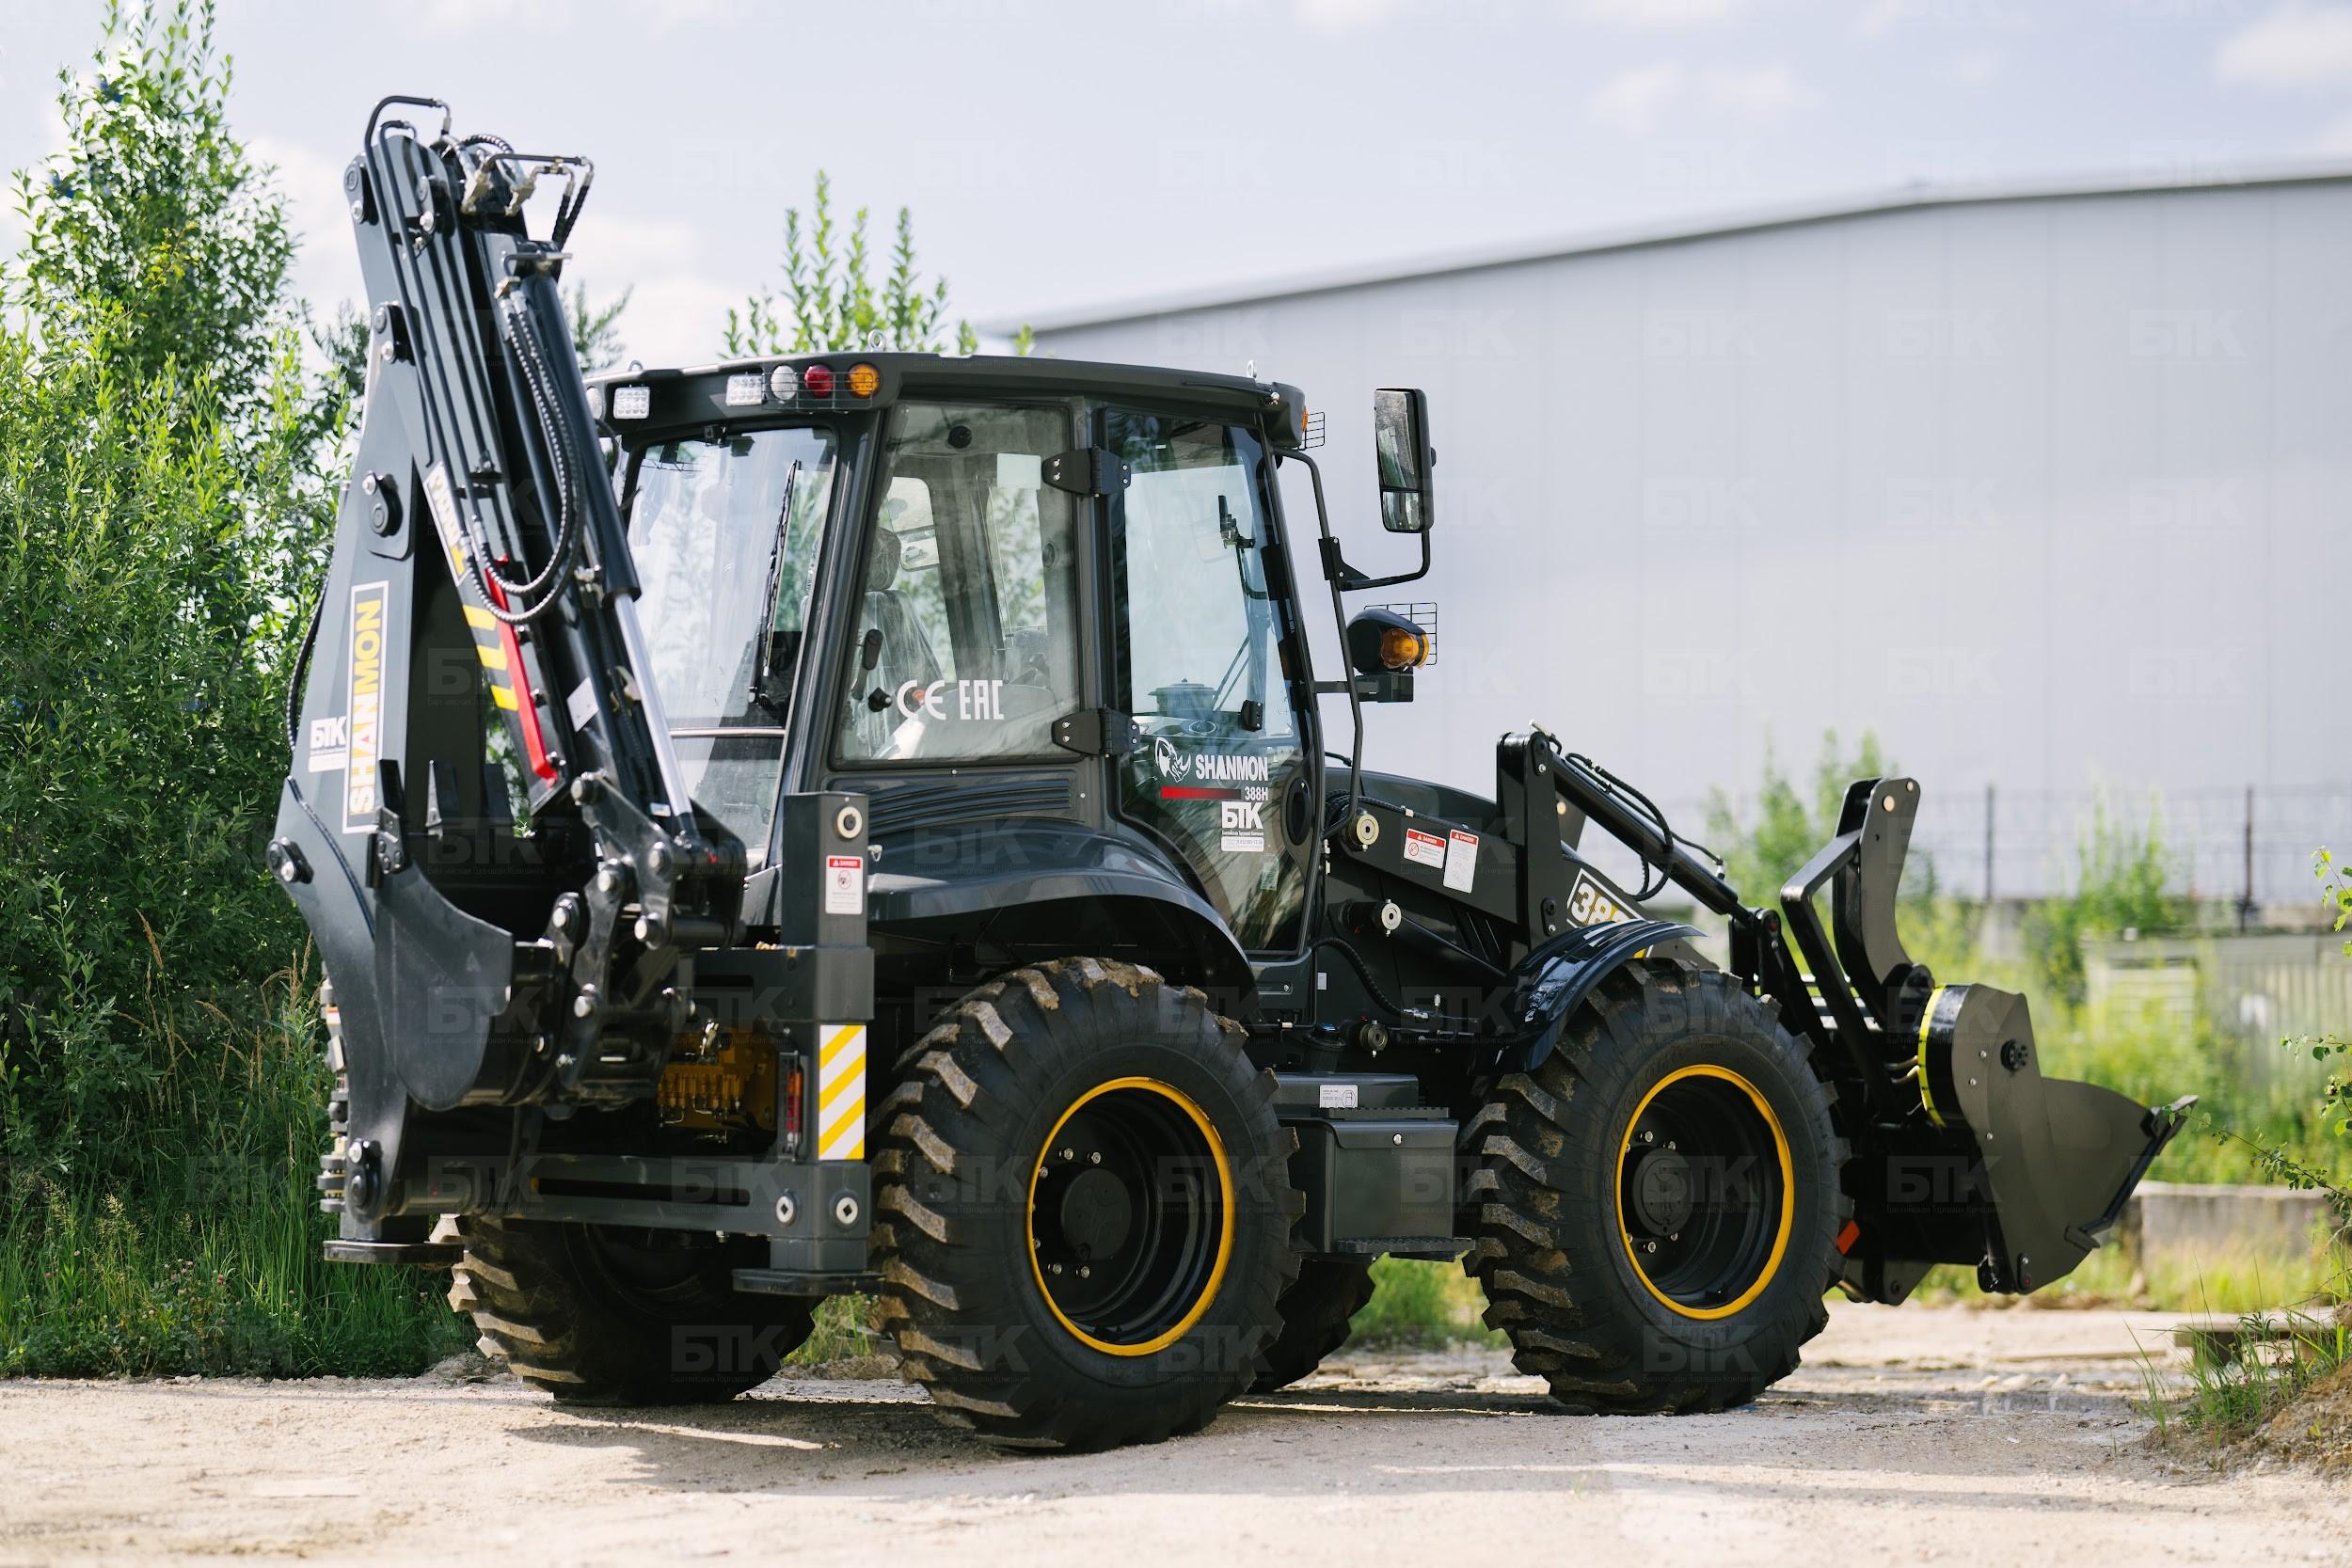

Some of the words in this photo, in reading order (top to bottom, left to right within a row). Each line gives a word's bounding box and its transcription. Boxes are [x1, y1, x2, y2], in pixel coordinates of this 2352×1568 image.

[349, 599, 383, 816] SHANMON
[310, 716, 347, 750] БТК
[1195, 753, 1269, 782] SHANMON
[1244, 786, 1269, 801] 388H
[1220, 800, 1264, 830] БТК
